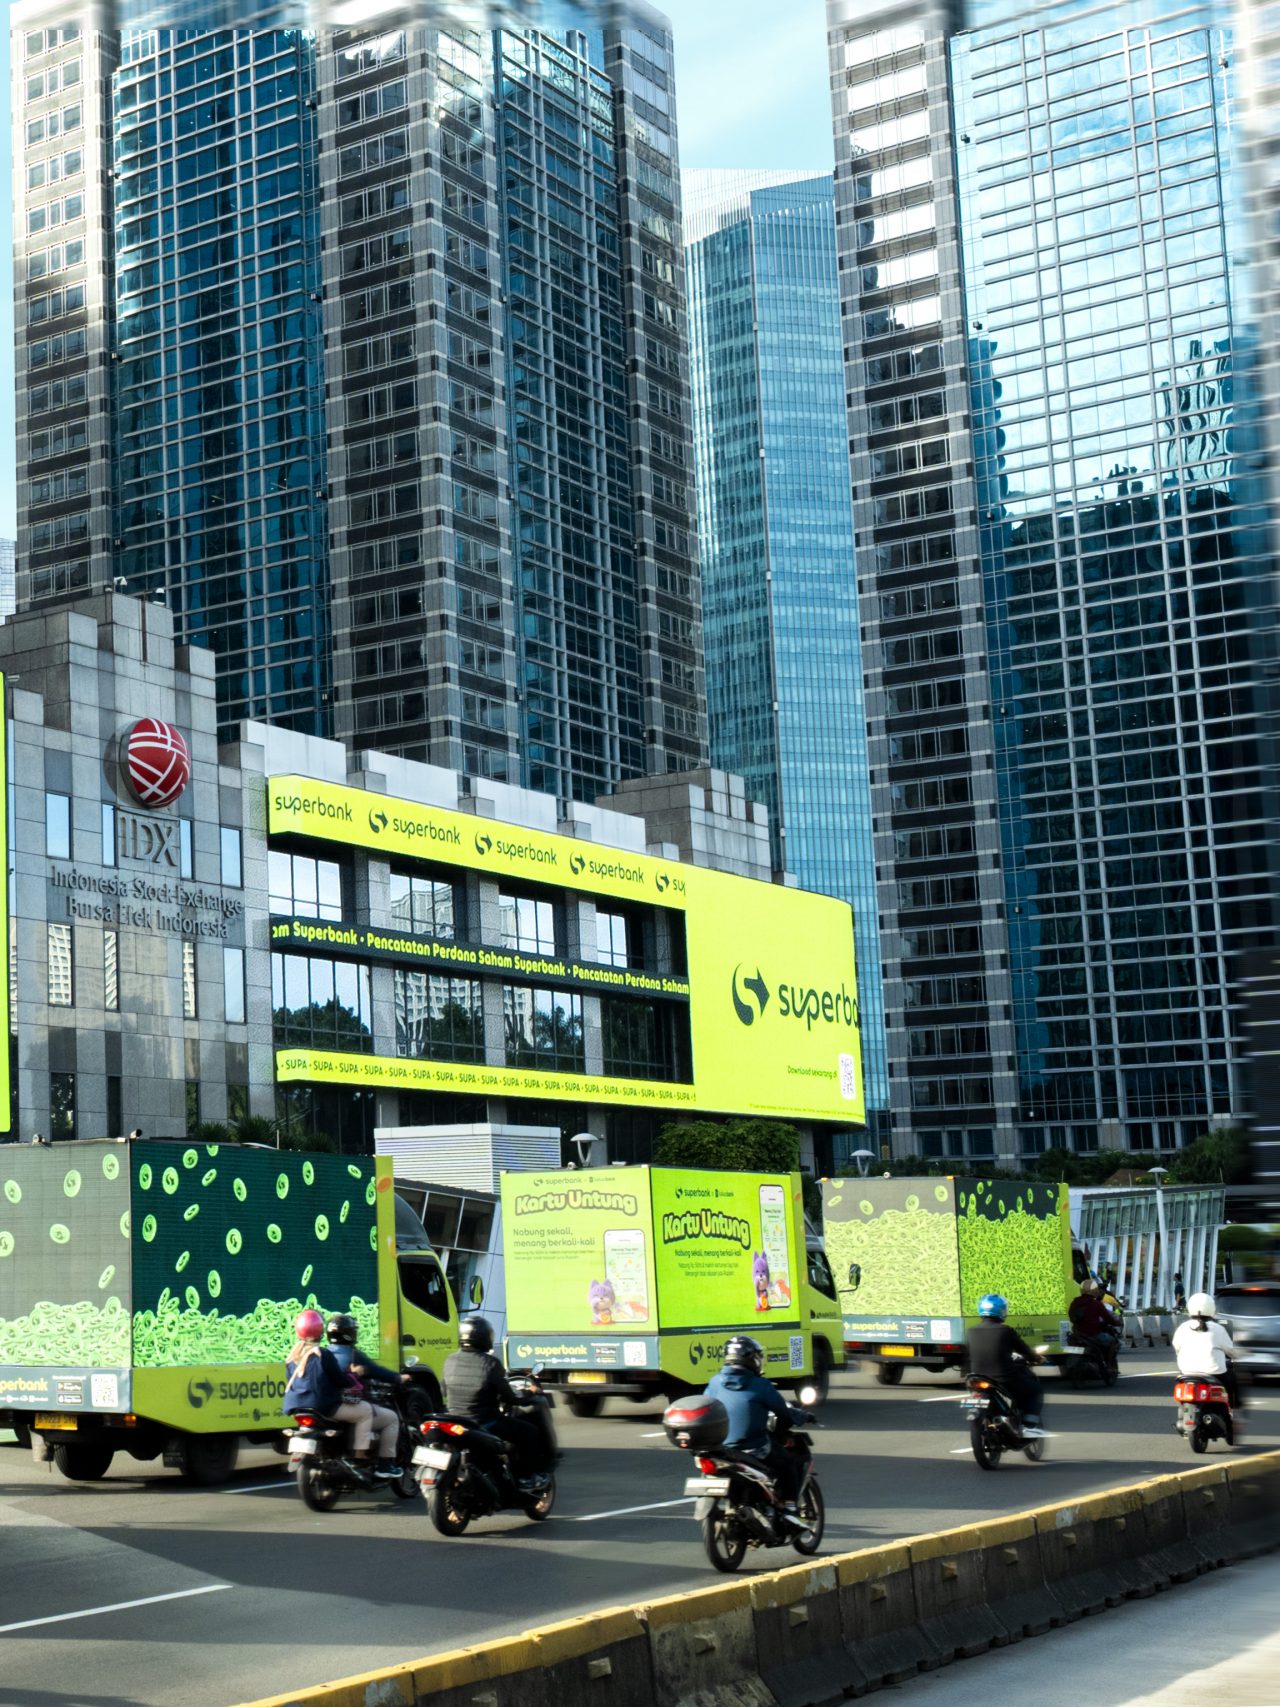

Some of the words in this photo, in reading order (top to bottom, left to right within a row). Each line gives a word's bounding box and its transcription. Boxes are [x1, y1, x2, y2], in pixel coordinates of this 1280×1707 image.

[120, 816, 178, 868] IDX
[275, 796, 353, 822] superbank
[393, 817, 461, 845] superbank
[496, 840, 557, 866] superbank
[589, 859, 645, 884] superbank
[51, 866, 129, 897] Indonesia
[133, 877, 173, 904] Stock
[176, 885, 245, 919] Exchange
[66, 896, 114, 923] Bursa
[117, 903, 153, 931] Efek
[157, 909, 230, 939] Indonesia
[293, 921, 358, 946] Superbank
[367, 933, 431, 957] Pencatatan
[433, 943, 477, 964] Perdana
[479, 949, 512, 969] Saham
[514, 955, 565, 976] Superbank
[573, 964, 624, 985] Pencatatan
[625, 973, 661, 989] Perdana
[662, 978, 689, 995] Saham
[285, 1059, 308, 1070] SUPA
[313, 1060, 333, 1072] SUPA
[339, 1062, 359, 1074] SUPA
[364, 1064, 384, 1076] SUPA
[389, 1066, 408, 1078] SUPA
[412, 1068, 431, 1080] SUPA
[436, 1070, 455, 1082] SUPA
[459, 1072, 477, 1084] SUPA
[481, 1074, 498, 1085] SUPA
[502, 1076, 520, 1087] SUPA
[524, 1078, 541, 1089] SUPA
[544, 1079, 561, 1090] SUPA
[564, 1081, 581, 1092] SUPA
[584, 1083, 600, 1094] SUPA
[603, 1085, 619, 1095] SUPA
[622, 1087, 637, 1097] SUPA
[641, 1088, 656, 1098] SUPA
[659, 1090, 673, 1099] SUPA
[676, 1091, 691, 1101] SUPA
[788, 1065, 811, 1076] Download
[546, 1176, 582, 1185] superbank
[515, 1191, 567, 1217] Kartu
[567, 1188, 638, 1217] Untung
[513, 1228, 545, 1238] Nabung
[514, 1240, 546, 1248] menang
[663, 1211, 701, 1245] Kartu
[701, 1208, 751, 1250] Untung
[851, 1322, 898, 1331] superbank
[534, 1344, 587, 1357] superbank
